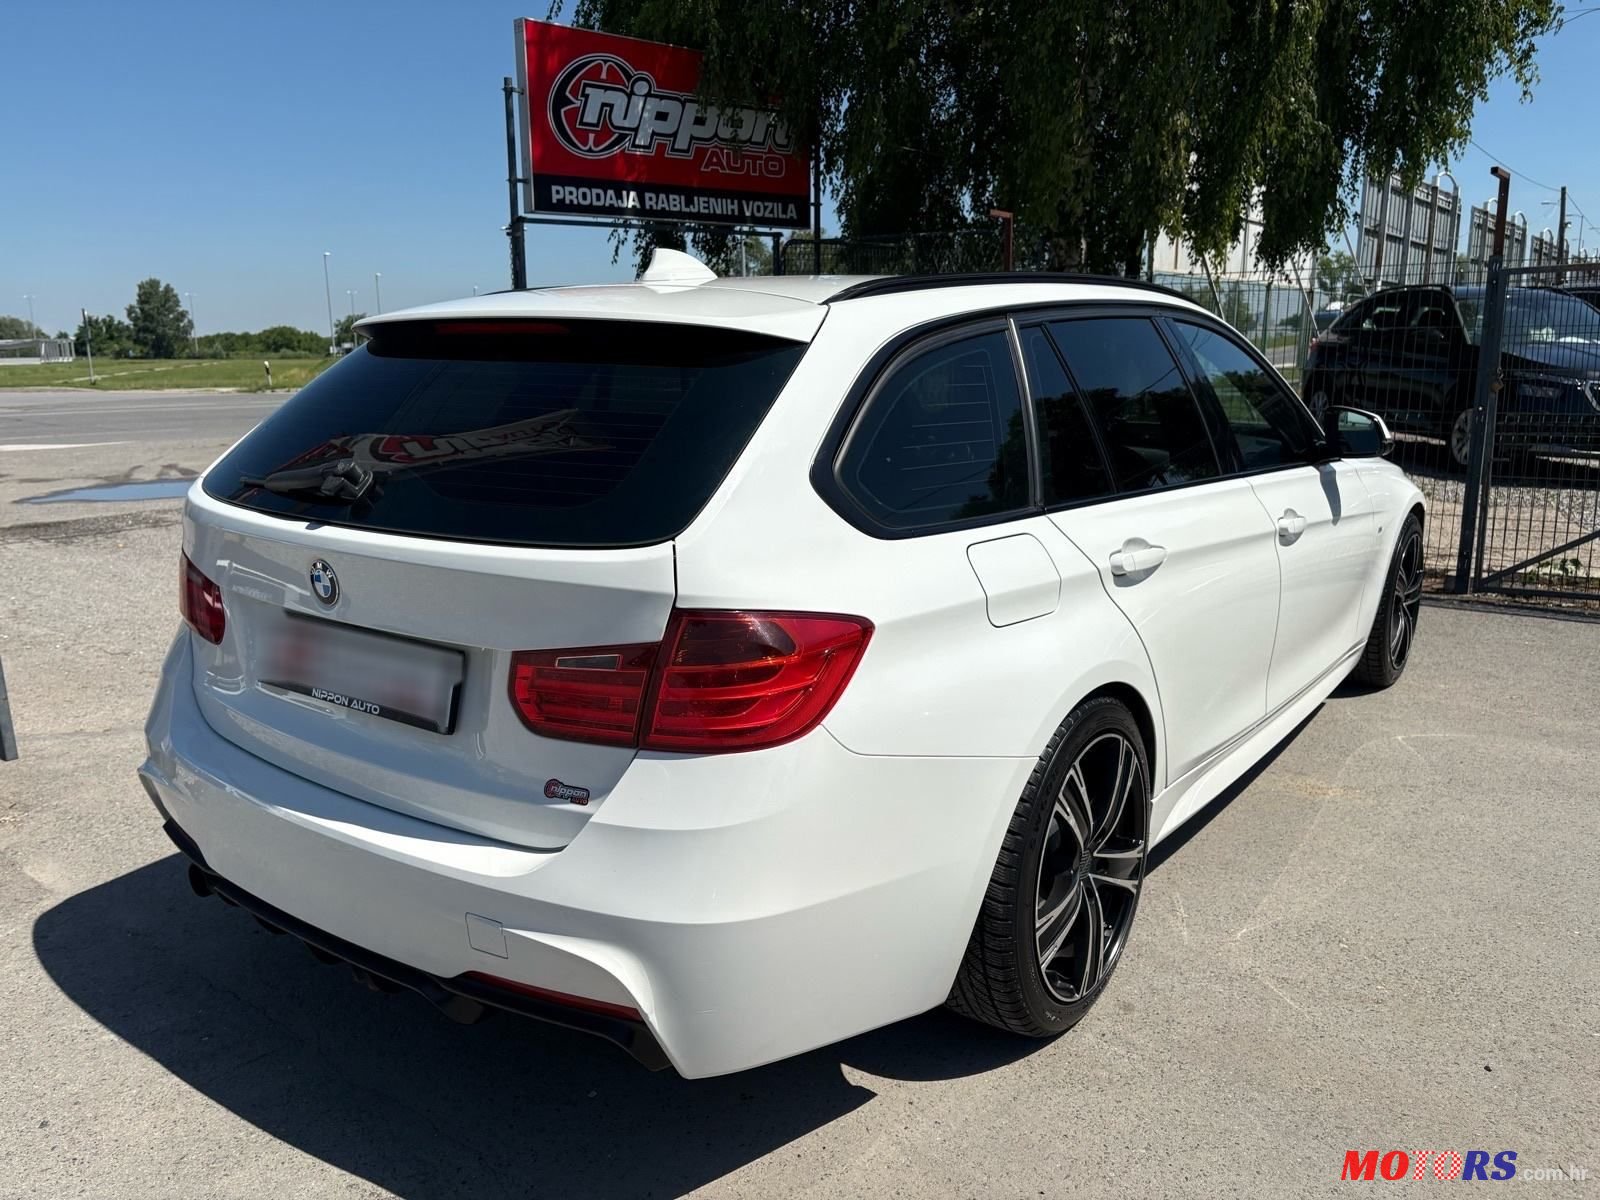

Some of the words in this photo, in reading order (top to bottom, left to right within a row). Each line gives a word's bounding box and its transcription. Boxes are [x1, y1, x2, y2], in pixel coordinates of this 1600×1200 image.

[580, 77, 791, 152] nippon
[701, 148, 785, 178] AUTO
[551, 185, 641, 209] PRODAJA
[645, 192, 738, 216] RABLJENIH
[743, 200, 797, 220] VOZILA
[312, 688, 349, 706] NIPPON
[351, 699, 380, 714] AUTO
